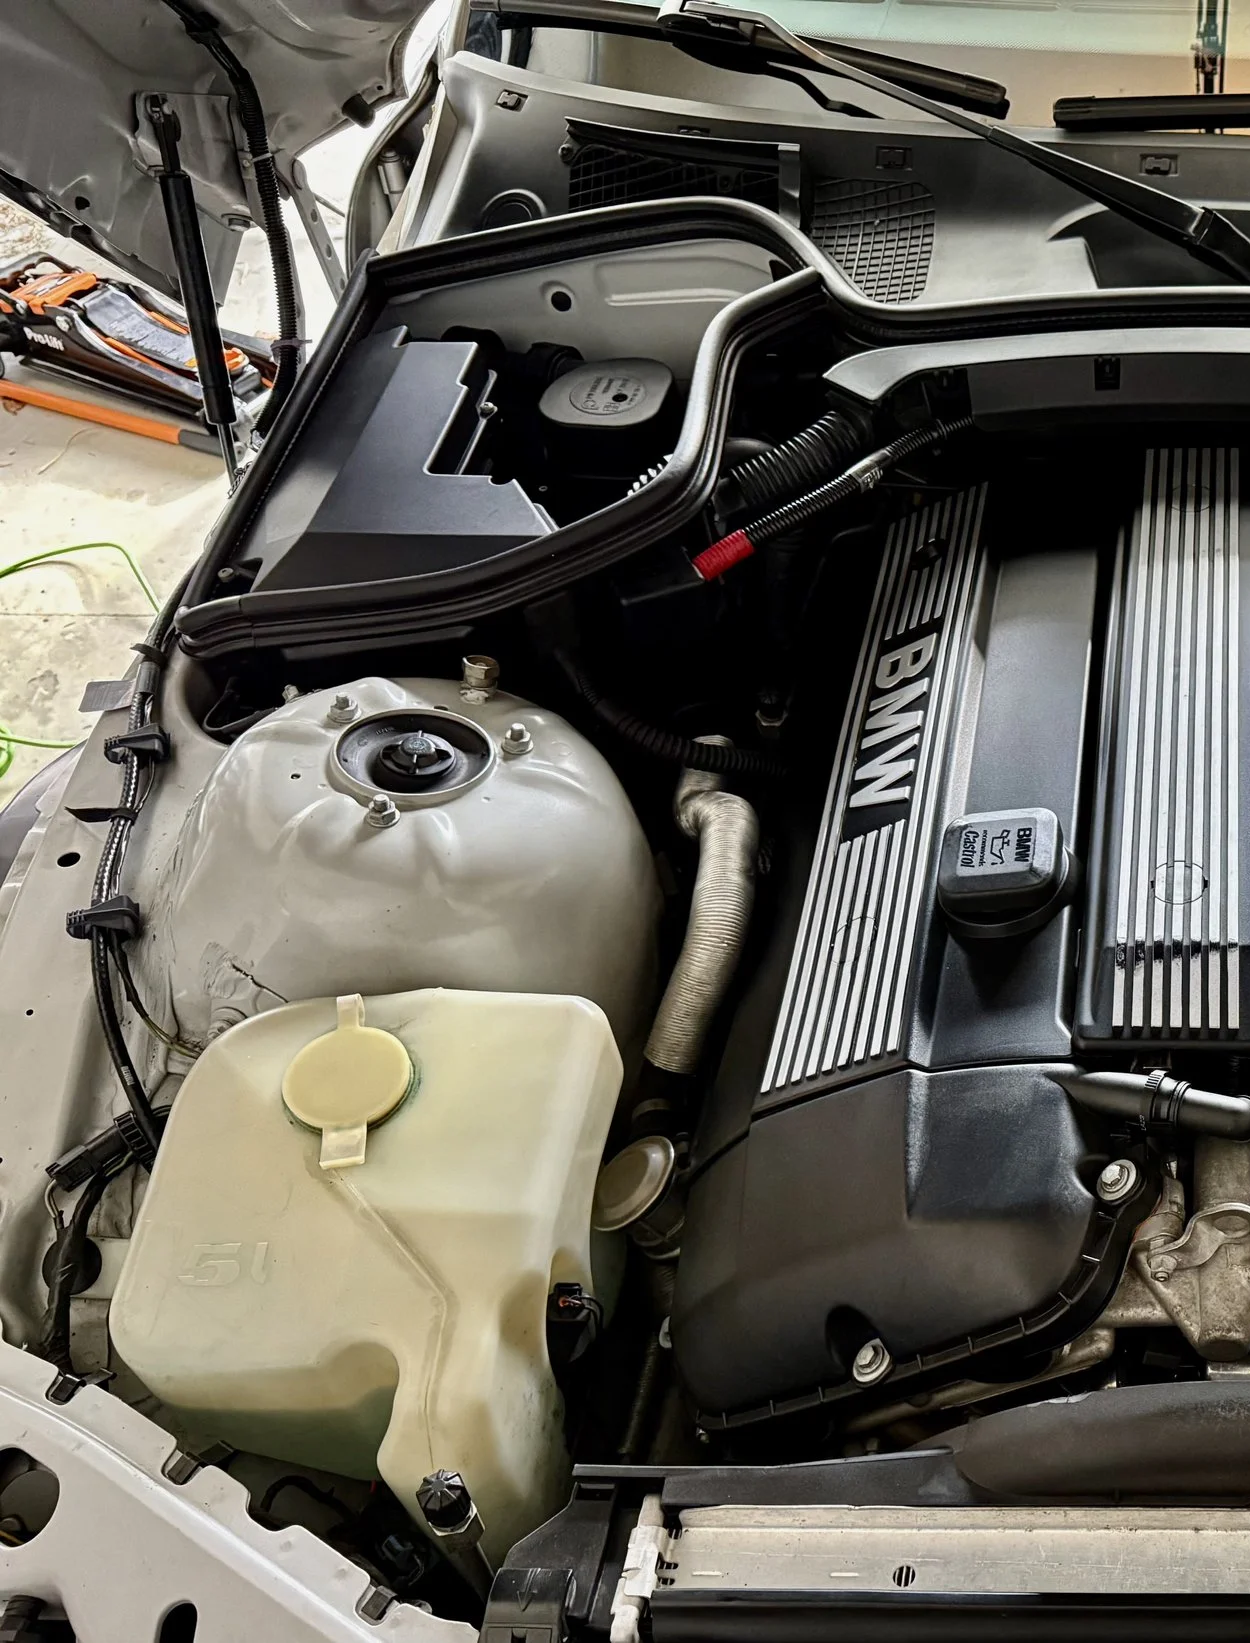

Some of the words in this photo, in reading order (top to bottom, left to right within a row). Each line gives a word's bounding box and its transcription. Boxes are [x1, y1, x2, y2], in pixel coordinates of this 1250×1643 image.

[849, 632, 938, 809] BMW
[960, 830, 980, 868] Castrol
[1014, 827, 1033, 863] BMW
